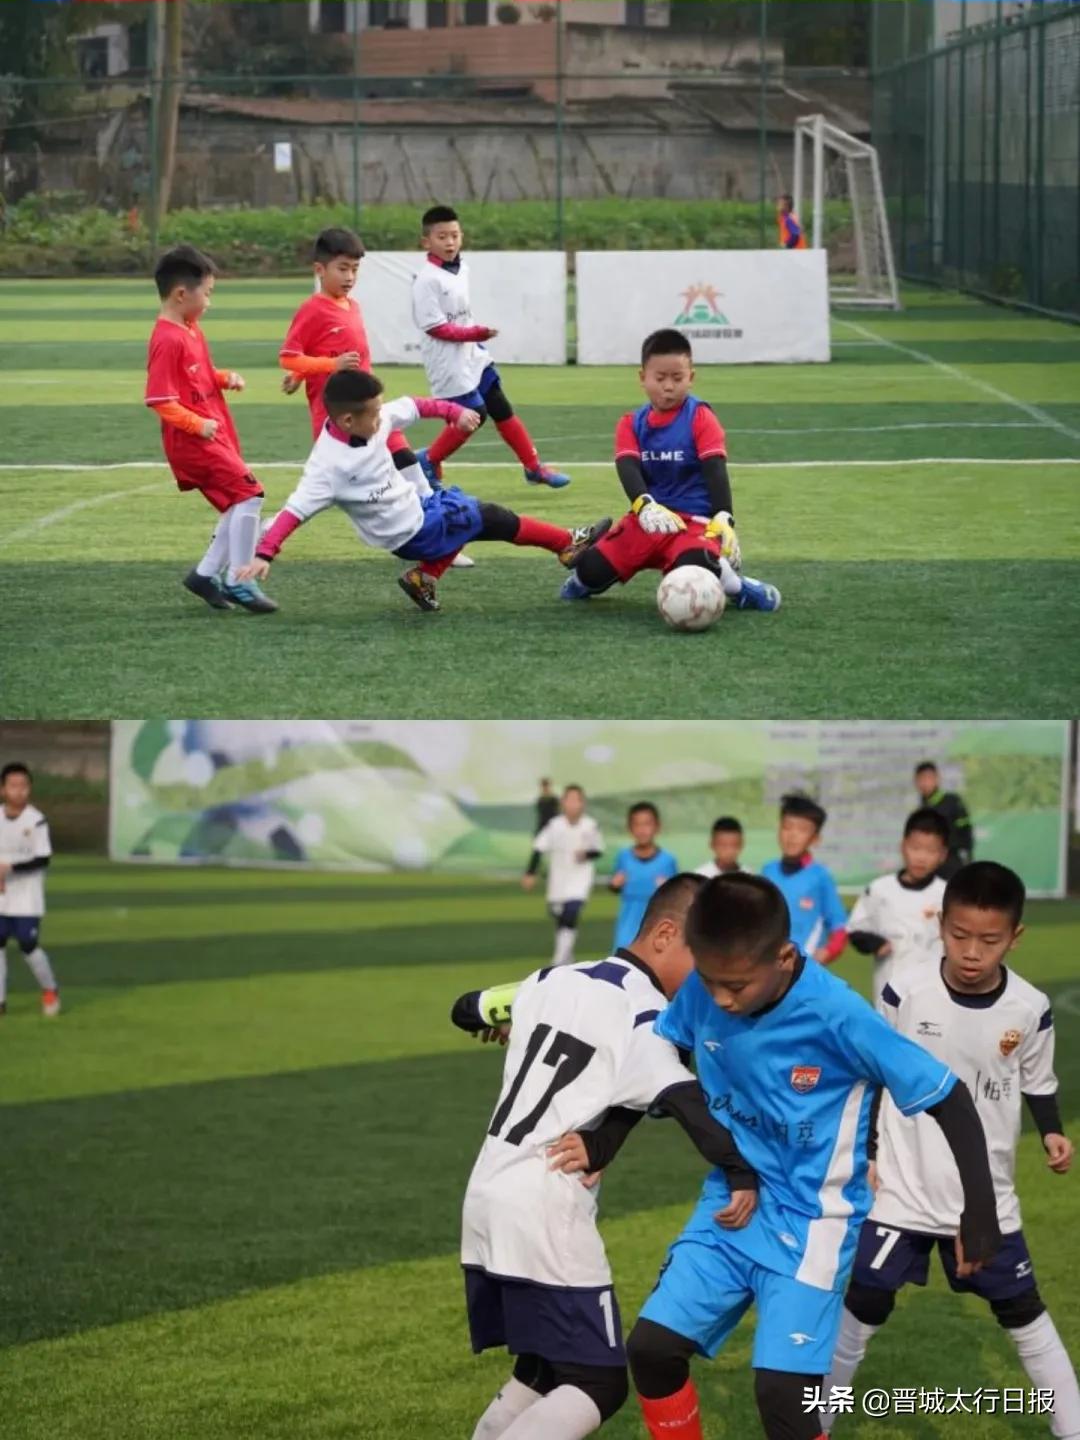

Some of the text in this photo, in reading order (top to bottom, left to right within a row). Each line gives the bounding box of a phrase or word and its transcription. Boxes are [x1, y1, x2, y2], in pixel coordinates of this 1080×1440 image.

[488, 1022, 597, 1147] 17
[869, 1226, 902, 1270] 7
[599, 1290, 617, 1348] 1
